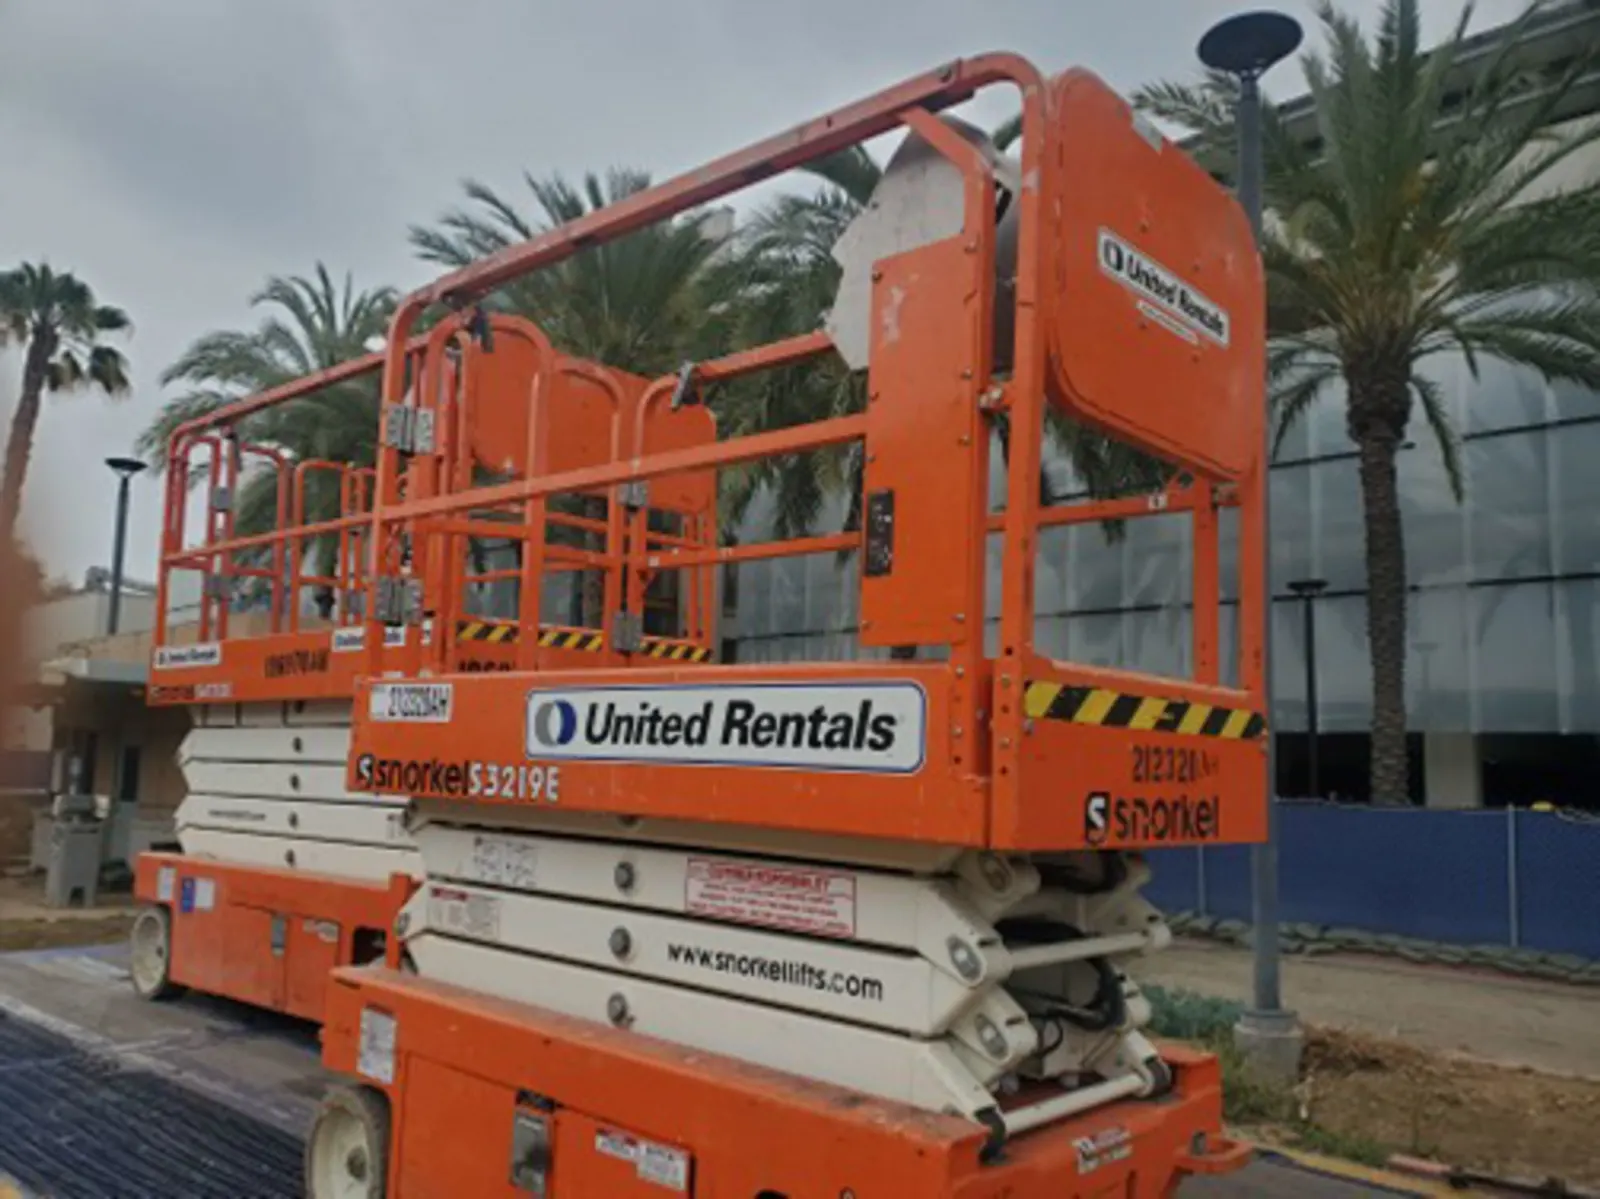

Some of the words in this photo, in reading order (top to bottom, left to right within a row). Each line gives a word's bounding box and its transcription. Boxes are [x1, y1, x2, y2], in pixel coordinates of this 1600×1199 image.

[584, 700, 714, 747] United
[720, 699, 897, 752] Rentals
[375, 758, 470, 796] snorkel
[468, 762, 560, 802] S3219E
[1114, 794, 1220, 841] snorkel
[667, 942, 884, 1001] www.snorkellifts.com
